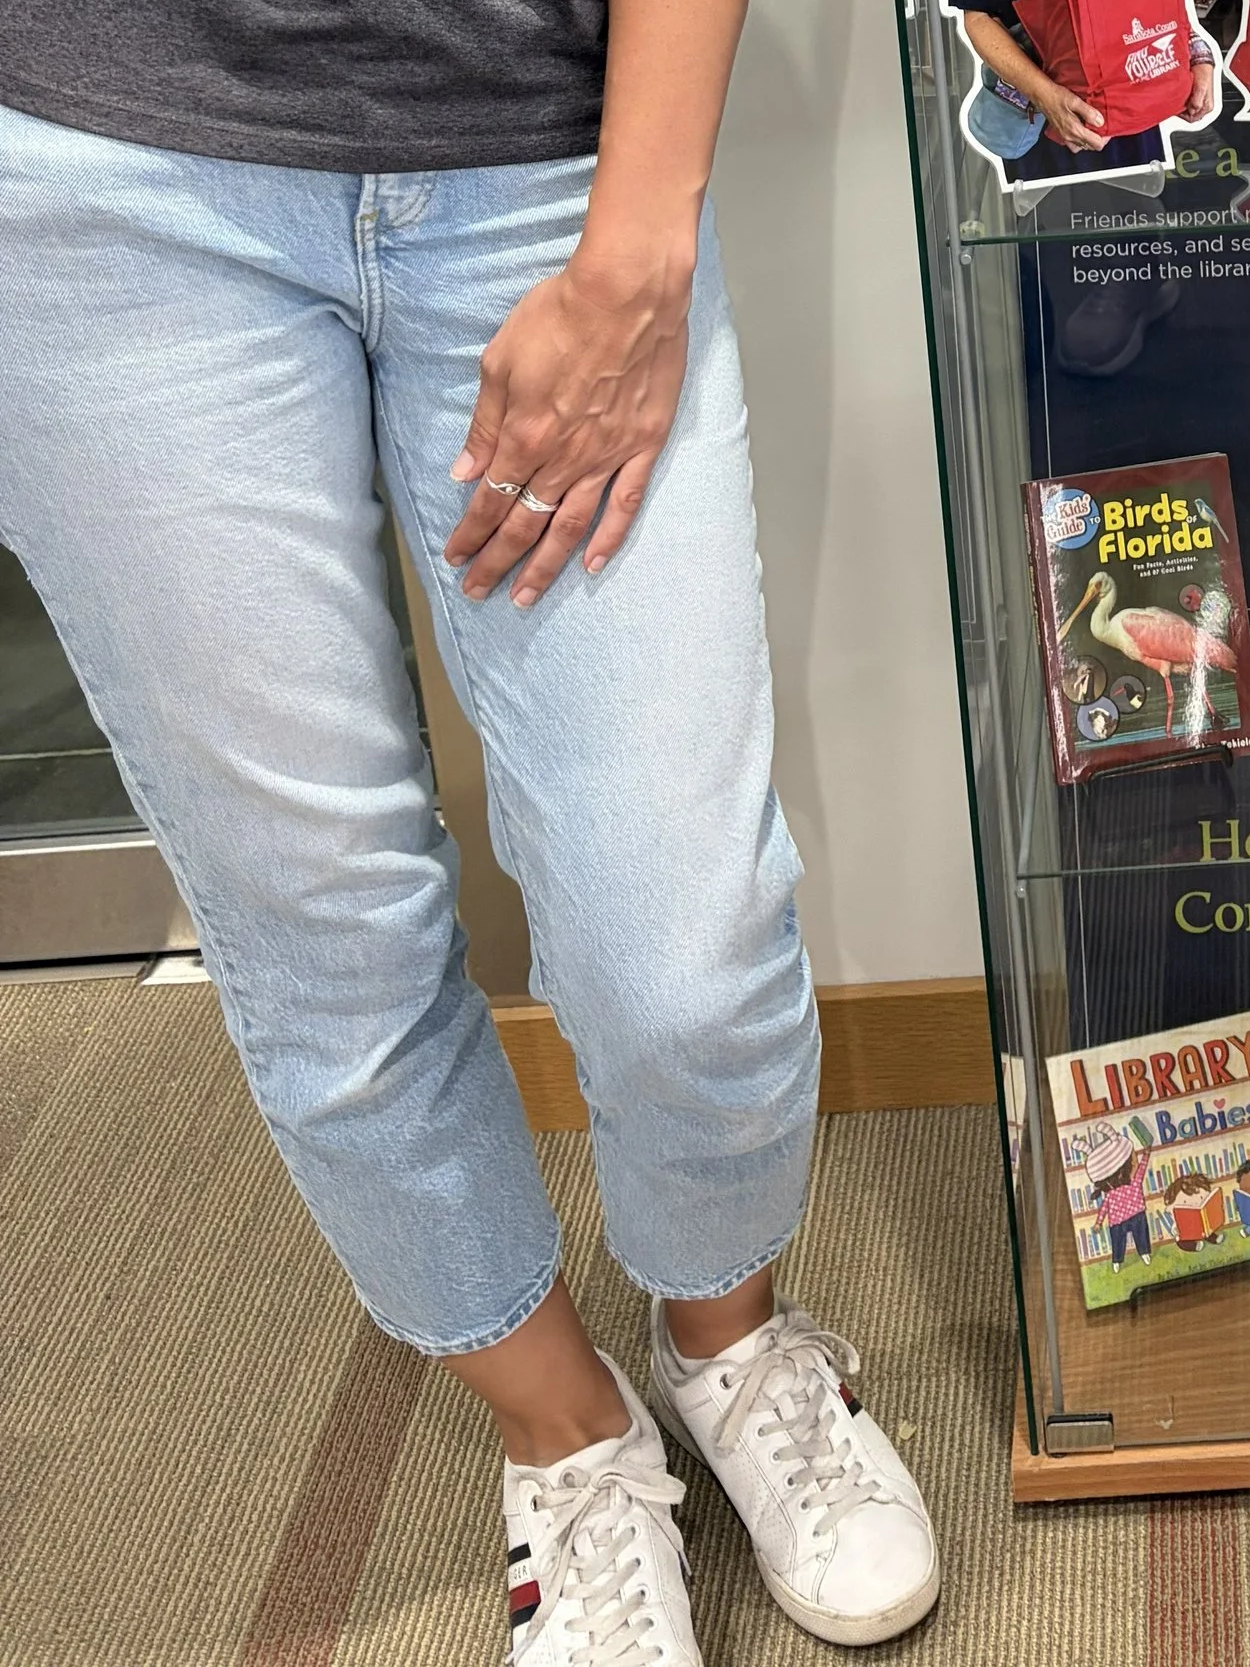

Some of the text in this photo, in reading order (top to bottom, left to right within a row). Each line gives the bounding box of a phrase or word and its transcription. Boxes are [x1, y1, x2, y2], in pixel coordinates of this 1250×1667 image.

[1149, 60, 1180, 78] LIBRARY
[1216, 146, 1242, 175] a
[1070, 210, 1149, 231] Friends
[1155, 206, 1238, 230] support
[1072, 237, 1178, 262] resources,
[1184, 235, 1225, 253] and
[1073, 261, 1153, 285] beyond
[1158, 260, 1193, 279] the
[1103, 493, 1198, 531] Birds OF
[1047, 517, 1101, 540] Guide TO
[1099, 523, 1213, 563] Florida
[1133, 563, 1145, 571] Fun
[1139, 570, 1151, 578] and
[1161, 567, 1176, 575] Cool
[1177, 565, 1193, 573] Birds
